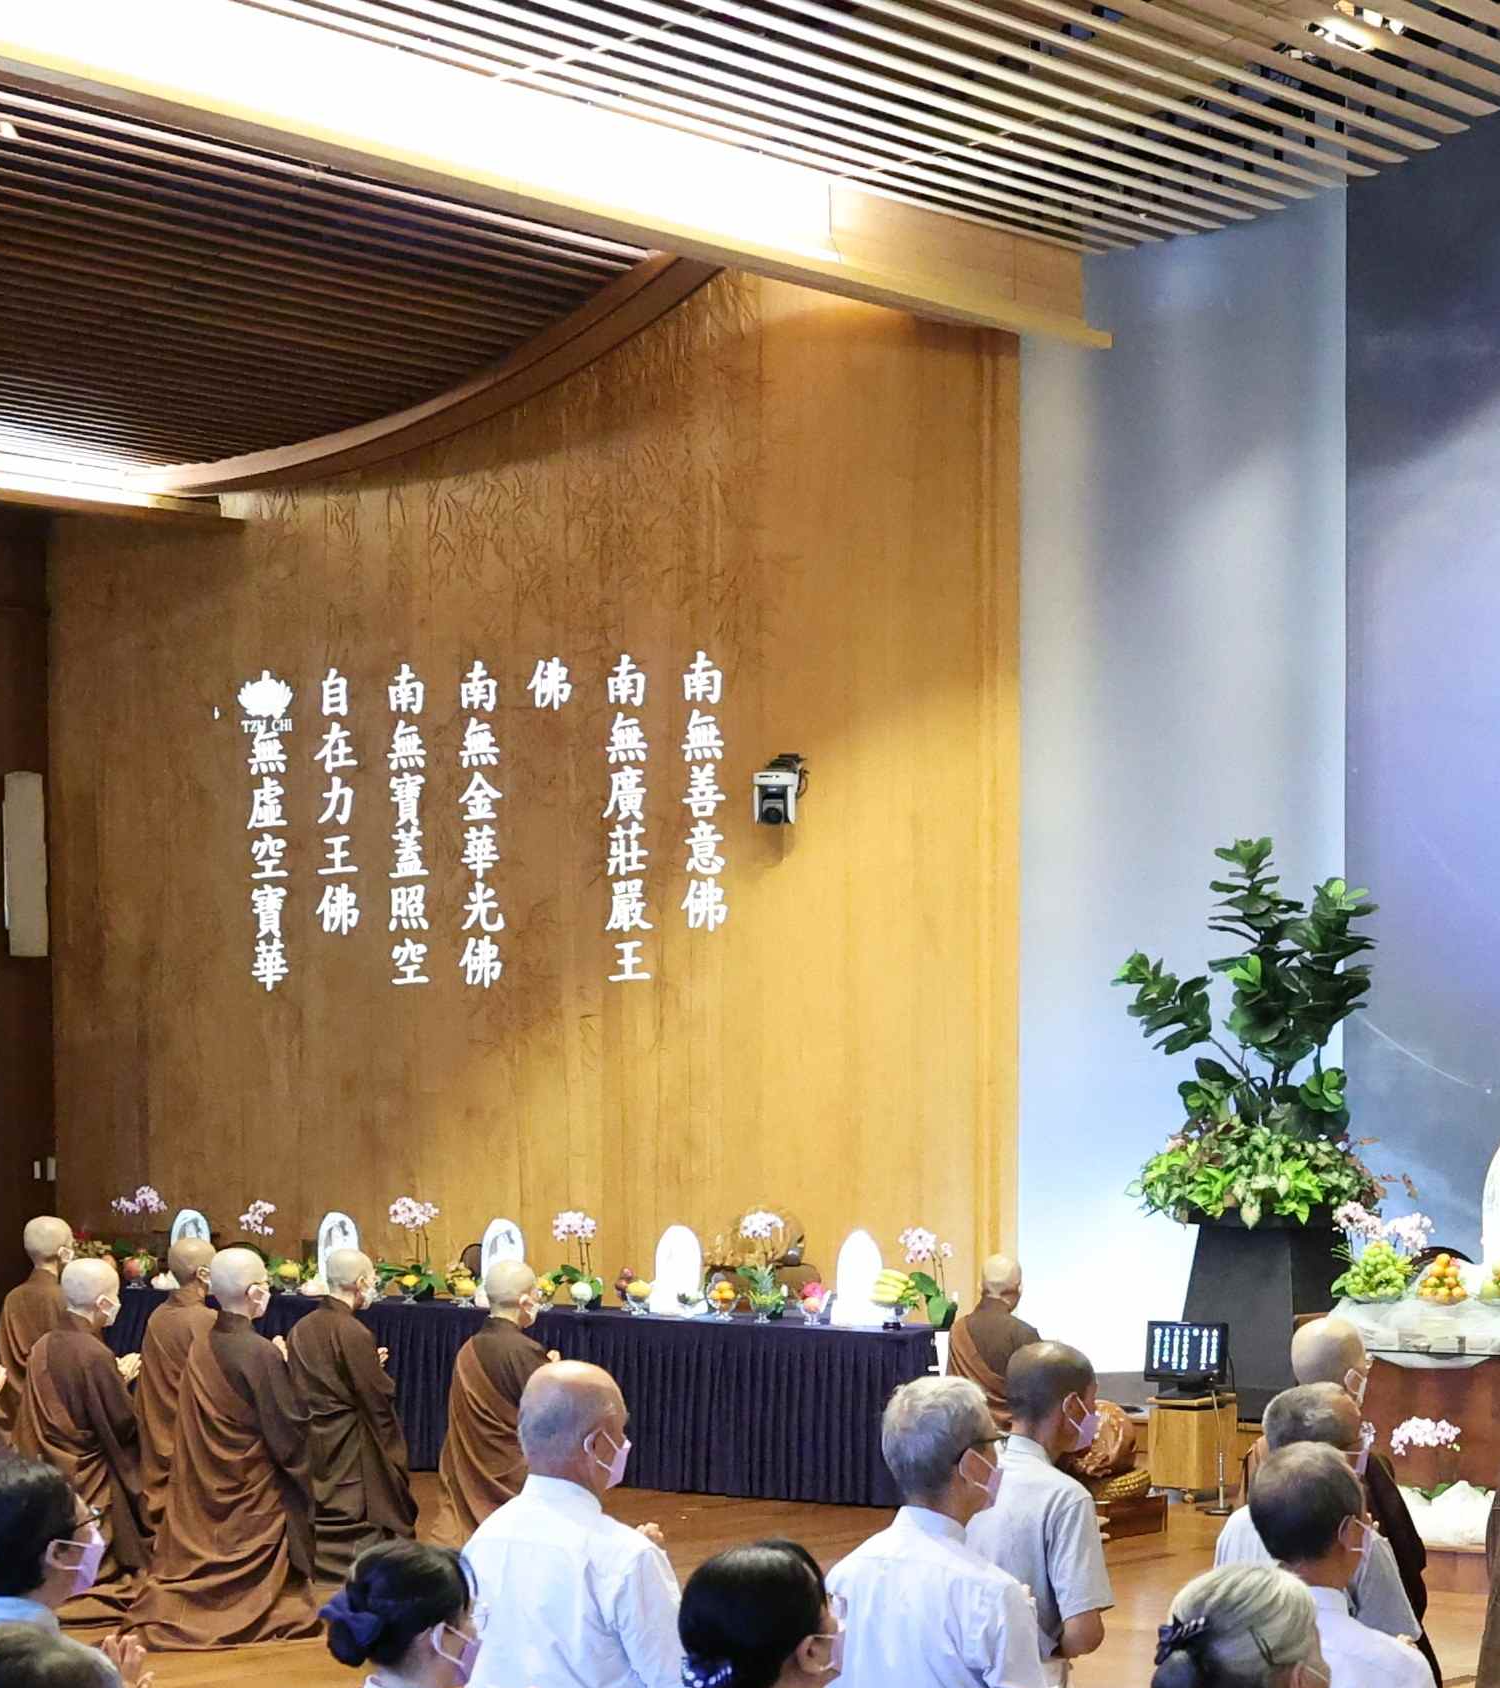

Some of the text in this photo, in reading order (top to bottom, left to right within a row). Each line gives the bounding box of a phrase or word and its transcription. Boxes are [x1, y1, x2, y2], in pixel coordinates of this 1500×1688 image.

[246, 670, 290, 992] 無虛空寶華
[313, 668, 360, 935] 自在力王佛
[386, 664, 430, 986] 南無寶蓋照空
[458, 661, 505, 988] 南無金華光佛
[526, 656, 572, 711] 佛
[602, 654, 653, 982] 南無廣莊嚴王
[682, 651, 728, 932] 南無善意佛
